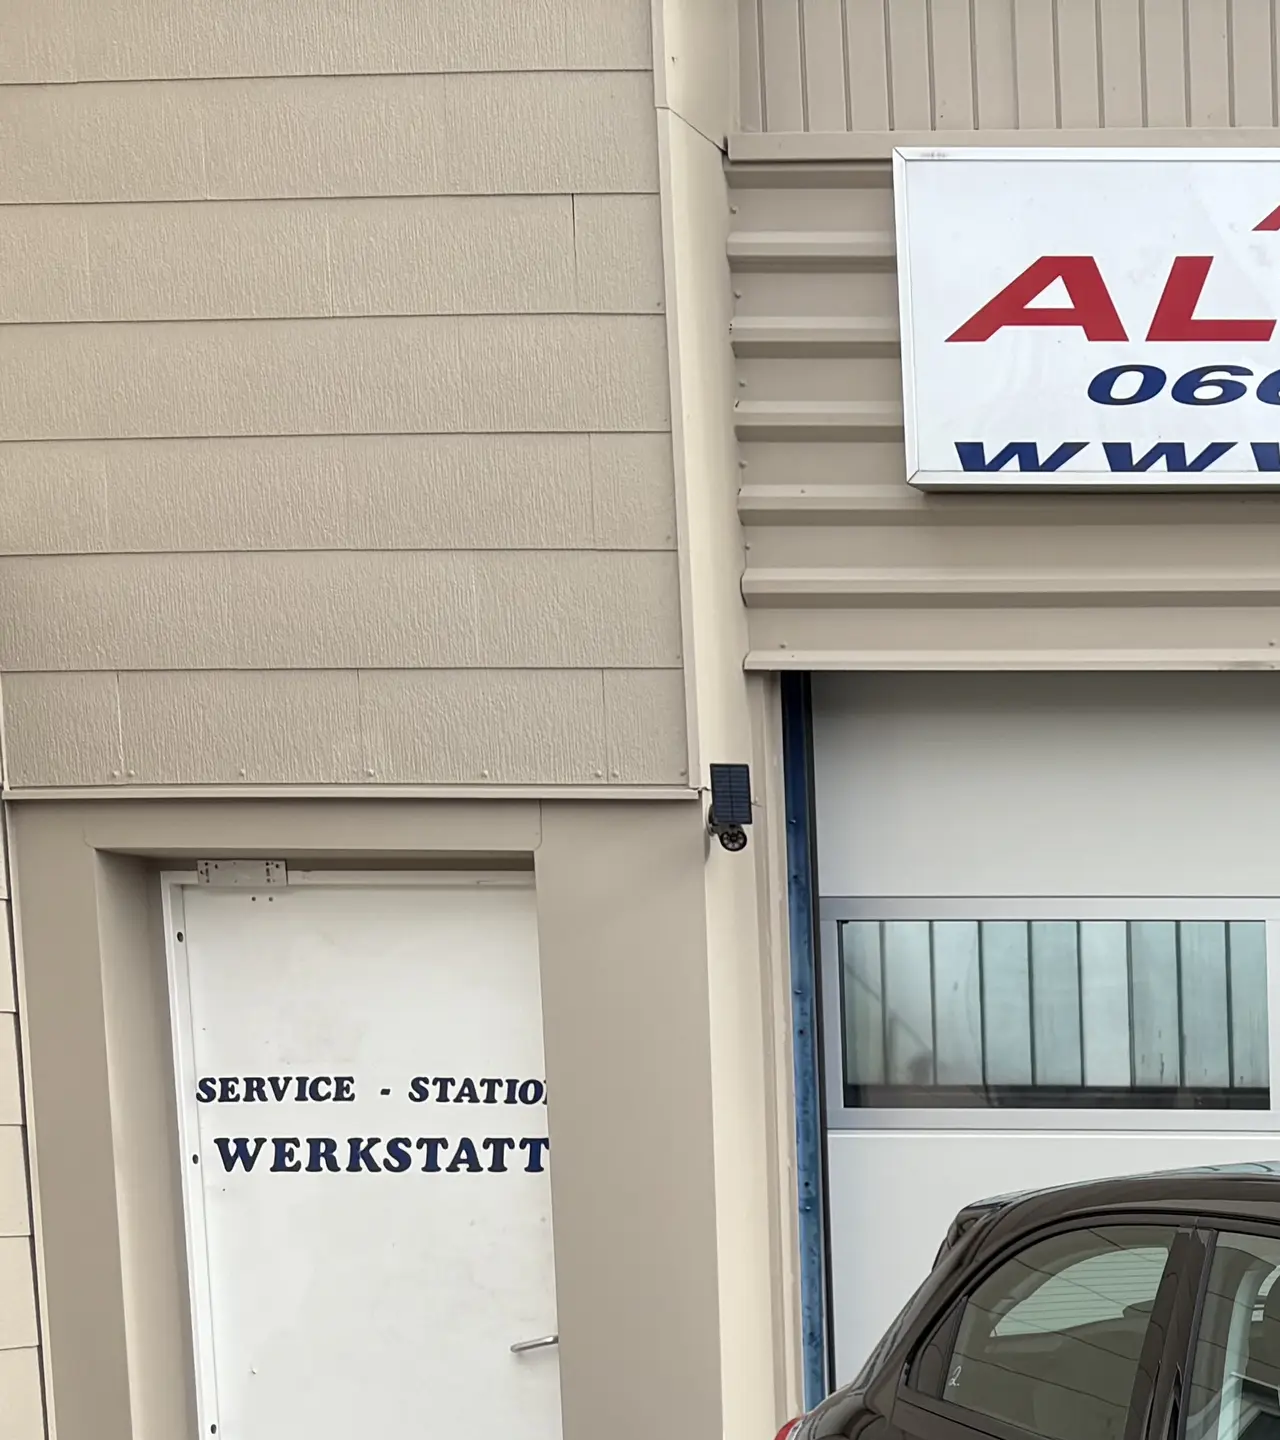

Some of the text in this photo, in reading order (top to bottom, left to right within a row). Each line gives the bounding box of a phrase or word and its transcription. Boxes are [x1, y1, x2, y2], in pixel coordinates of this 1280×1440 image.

[196, 1076, 356, 1103] SERVICE
[408, 1076, 548, 1106] STATIO
[213, 1137, 550, 1173] WERKSTATT
